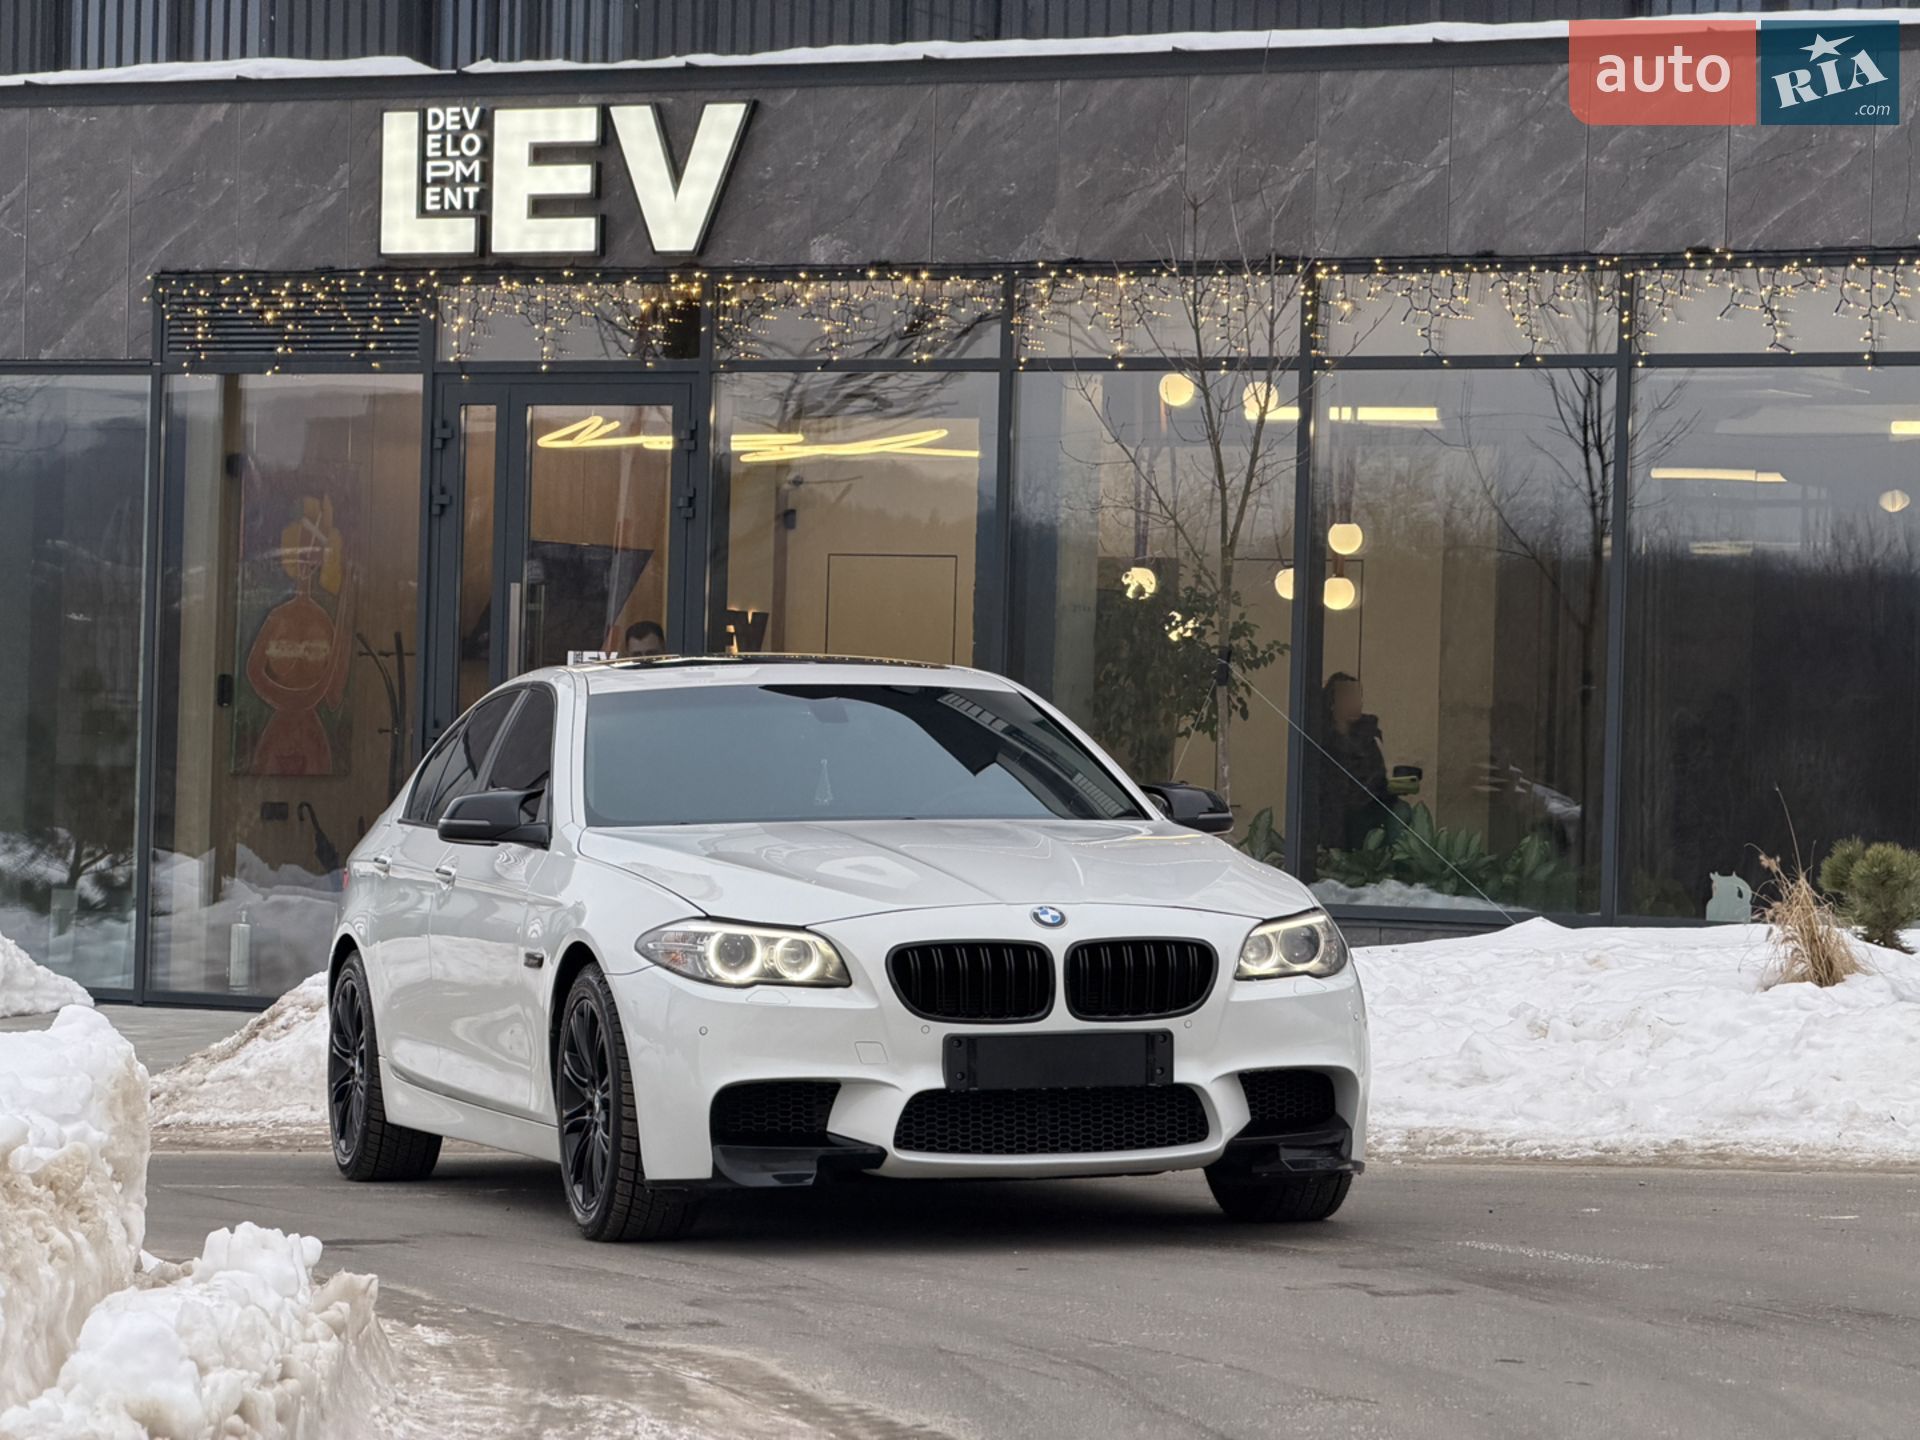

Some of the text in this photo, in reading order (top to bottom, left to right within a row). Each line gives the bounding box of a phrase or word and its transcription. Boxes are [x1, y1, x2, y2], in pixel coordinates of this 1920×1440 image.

[427, 106, 481, 131] DEV
[426, 133, 481, 157] ELO
[379, 102, 750, 254] LEV
[426, 160, 480, 184] PM
[425, 187, 480, 210] ENT
